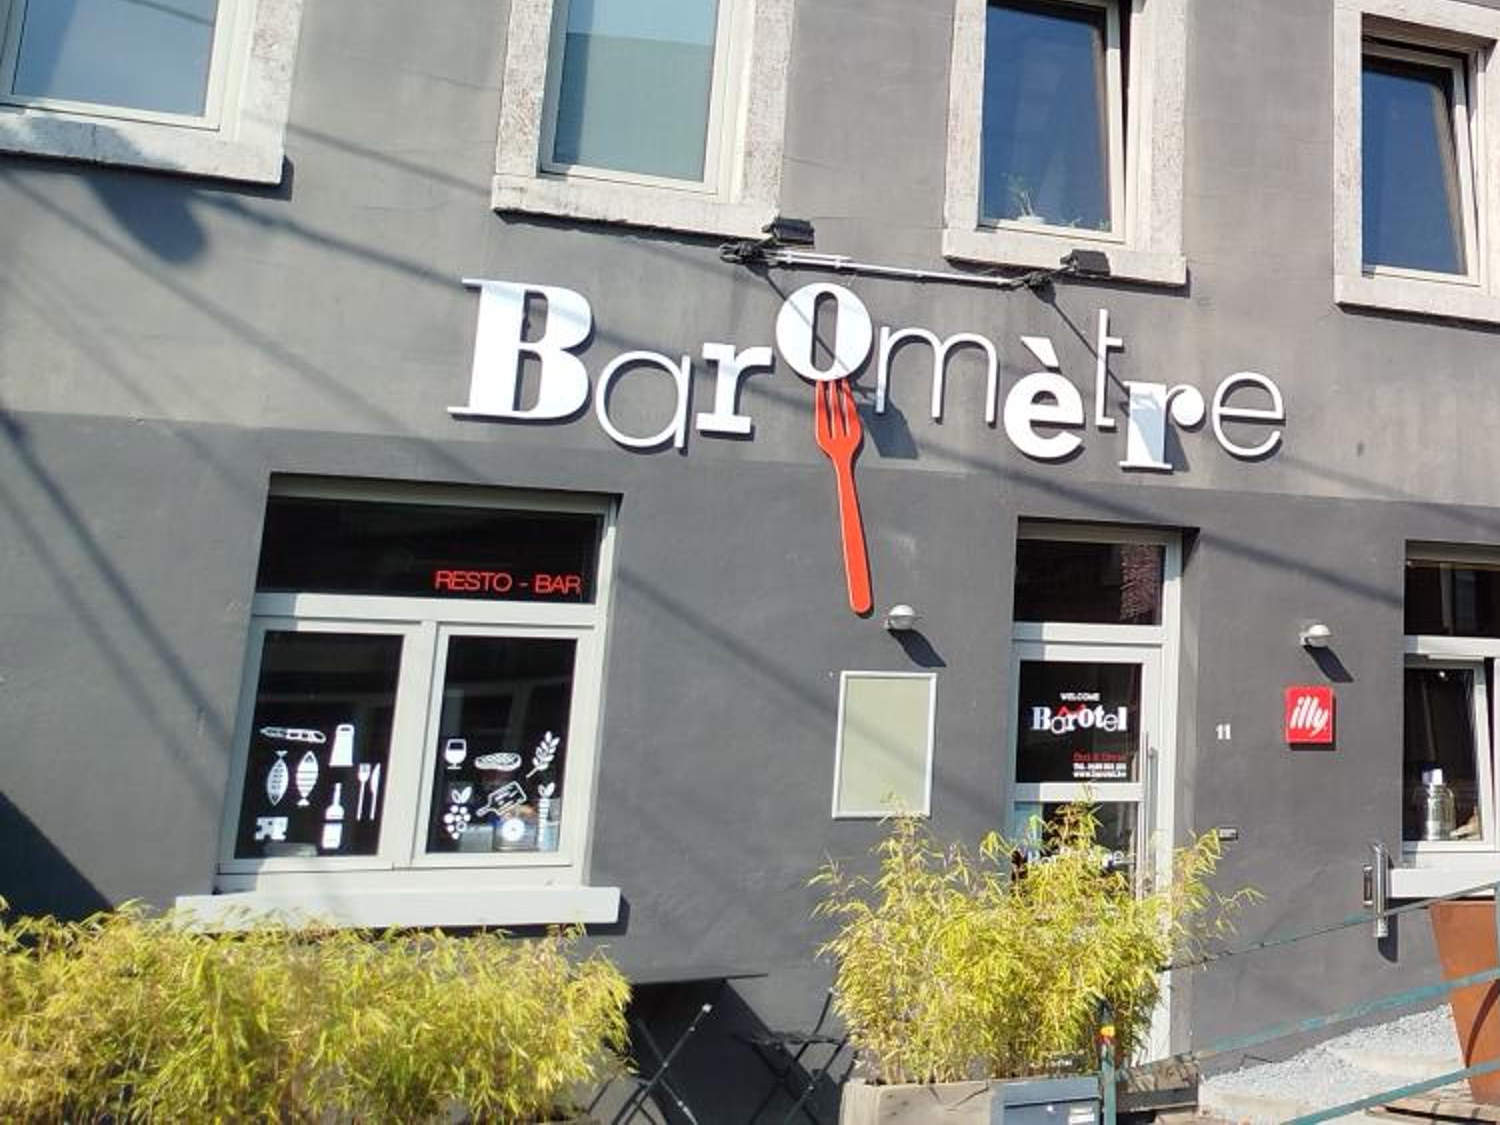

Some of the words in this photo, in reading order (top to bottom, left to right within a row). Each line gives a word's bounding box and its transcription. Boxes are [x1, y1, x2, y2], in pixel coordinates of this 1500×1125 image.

[434, 570, 512, 592] RESTO
[535, 575, 582, 594] BAR
[1060, 693, 1100, 702] WELCOME
[1290, 696, 1328, 736] illy
[1216, 724, 1232, 740] 11
